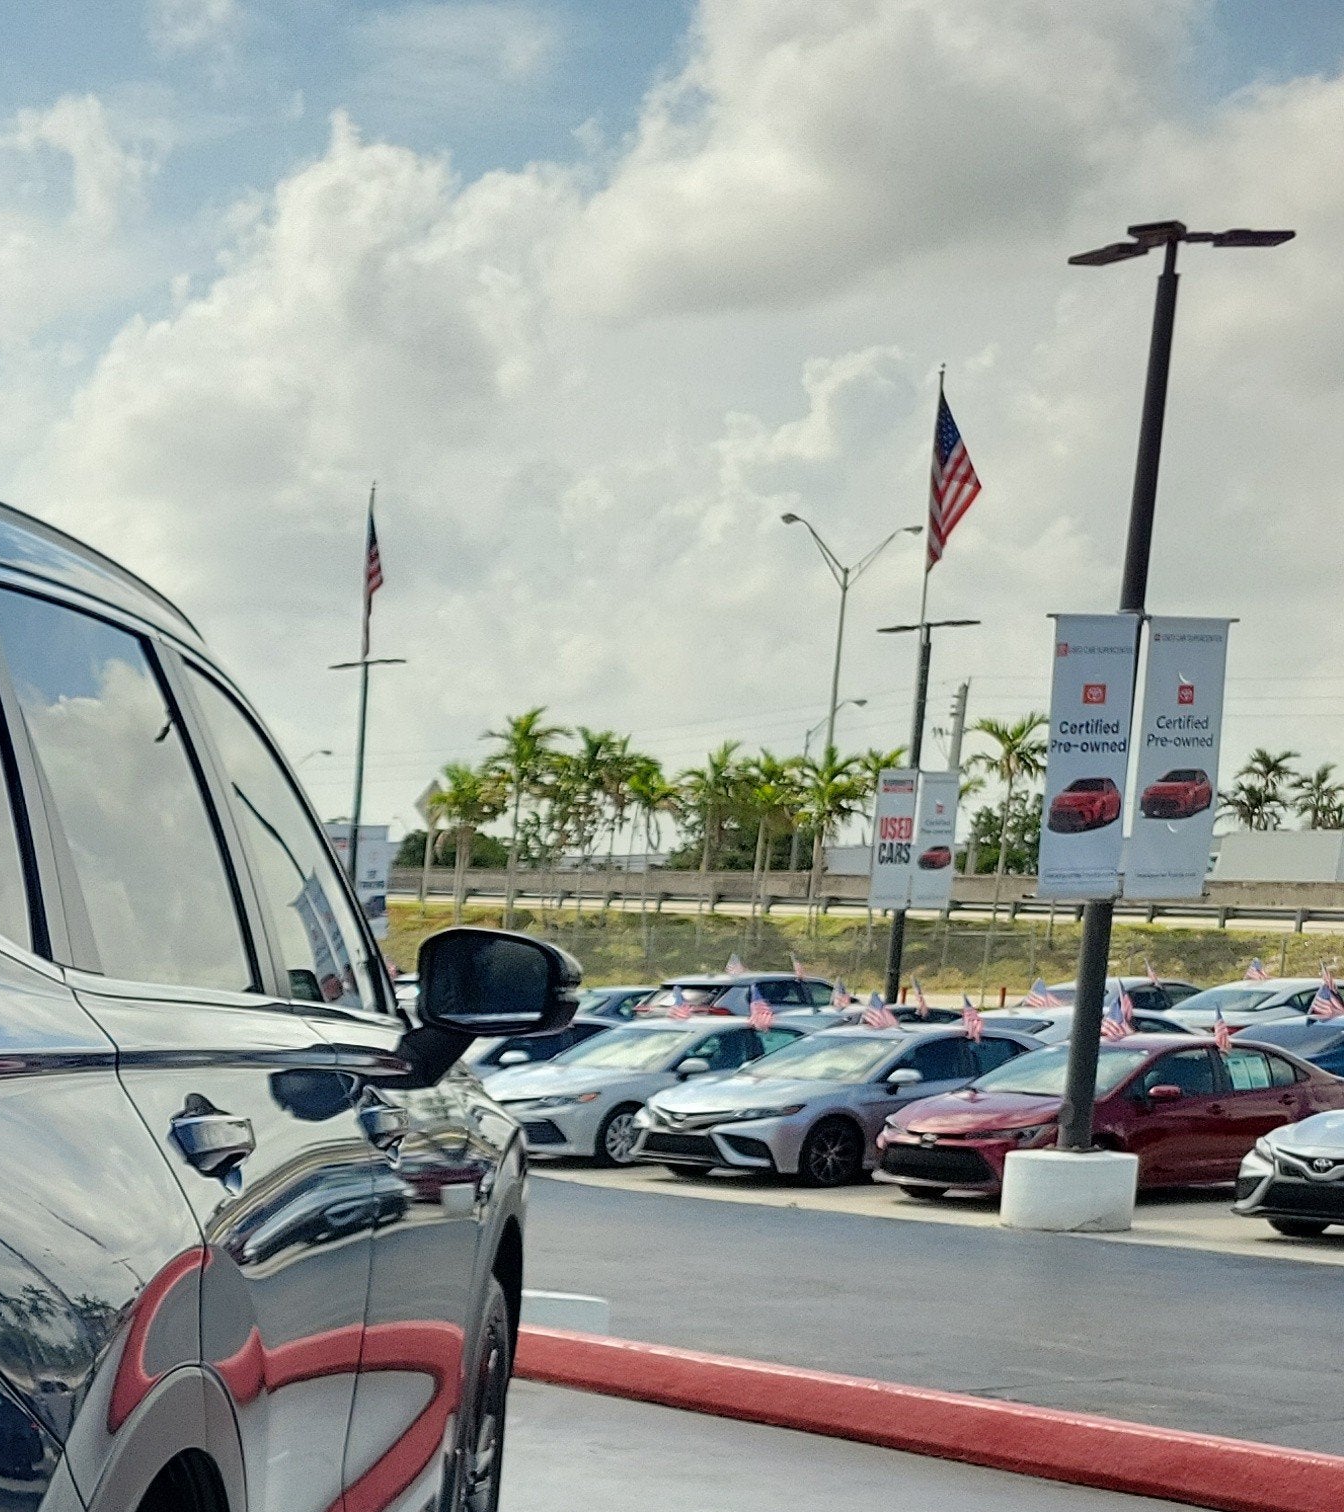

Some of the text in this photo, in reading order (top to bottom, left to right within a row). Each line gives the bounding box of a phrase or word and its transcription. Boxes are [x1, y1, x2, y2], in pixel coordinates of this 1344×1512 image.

[1059, 719, 1120, 735] Certified
[1156, 715, 1210, 730] Certified
[1051, 737, 1128, 753] Pre-owned
[1146, 733, 1214, 748] Pre-owned
[880, 817, 912, 840] USED
[878, 842, 911, 864] CARS
